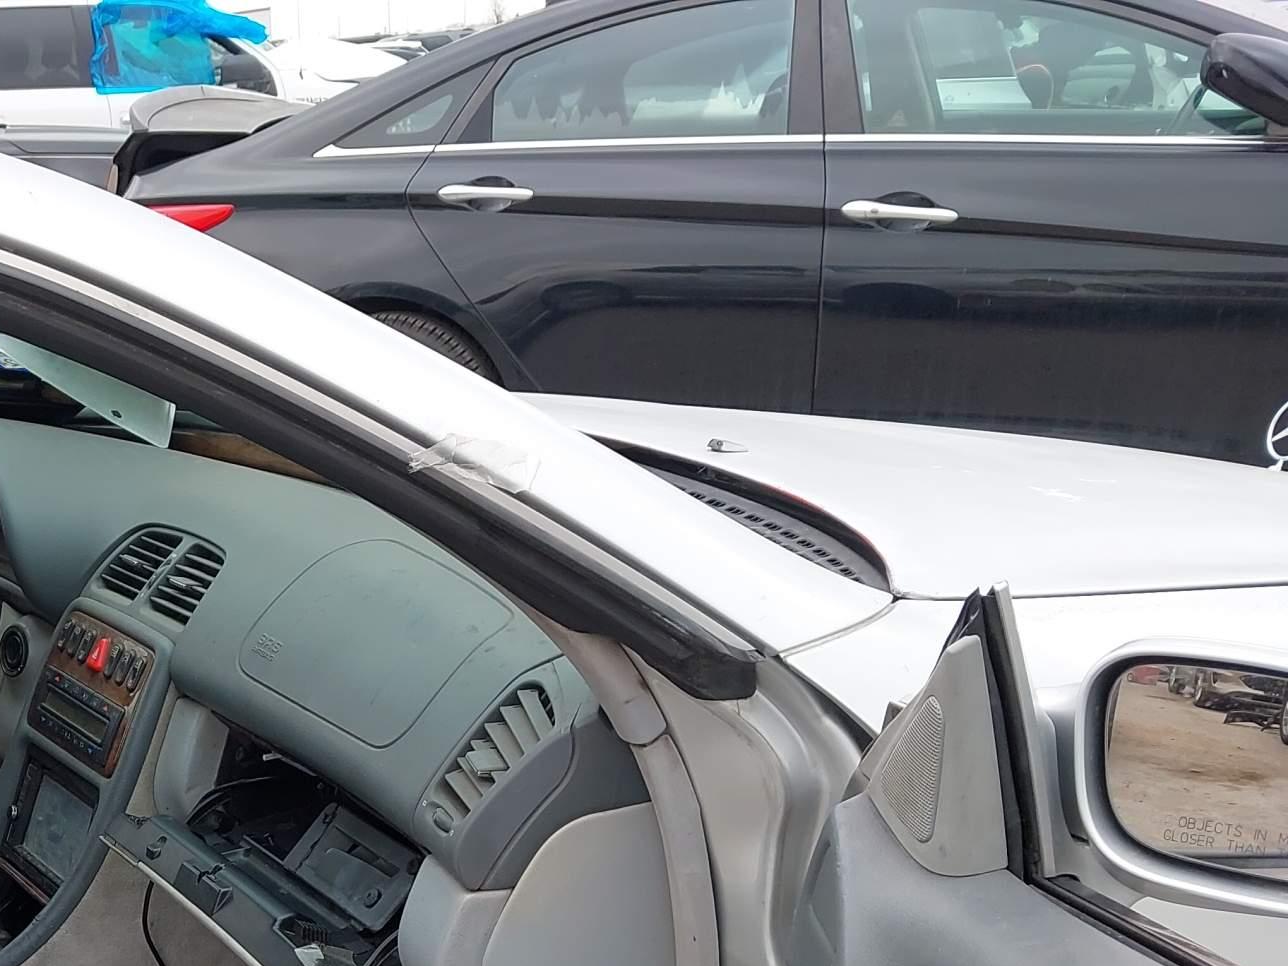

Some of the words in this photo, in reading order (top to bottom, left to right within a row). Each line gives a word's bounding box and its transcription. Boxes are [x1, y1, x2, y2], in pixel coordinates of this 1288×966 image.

[1178, 815, 1244, 838] OBJECTS
[1253, 828, 1269, 841] IN
[1163, 828, 1215, 848] CLOSER
[1227, 839, 1267, 857] THAN
